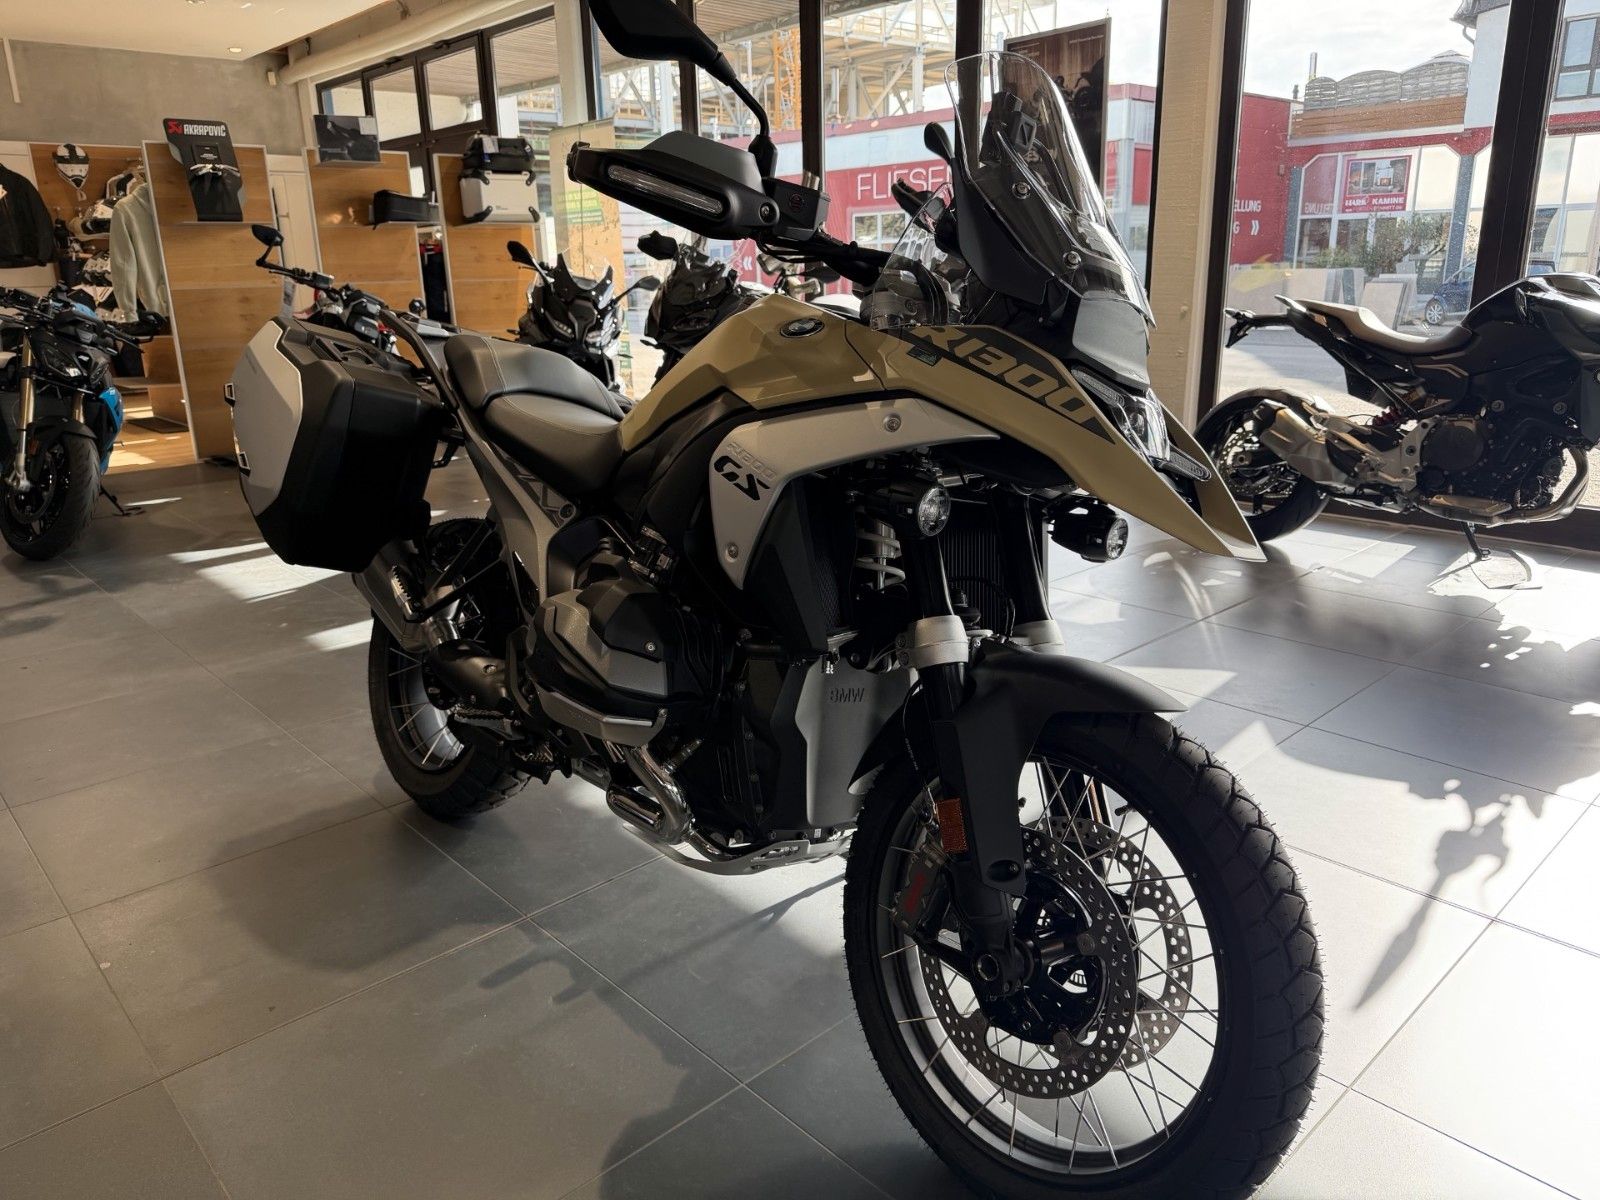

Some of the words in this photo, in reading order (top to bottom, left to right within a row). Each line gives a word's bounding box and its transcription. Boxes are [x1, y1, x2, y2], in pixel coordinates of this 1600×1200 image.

[857, 165, 952, 200] FLISE
[1371, 197, 1405, 205] KAMINE
[713, 455, 770, 501] GS
